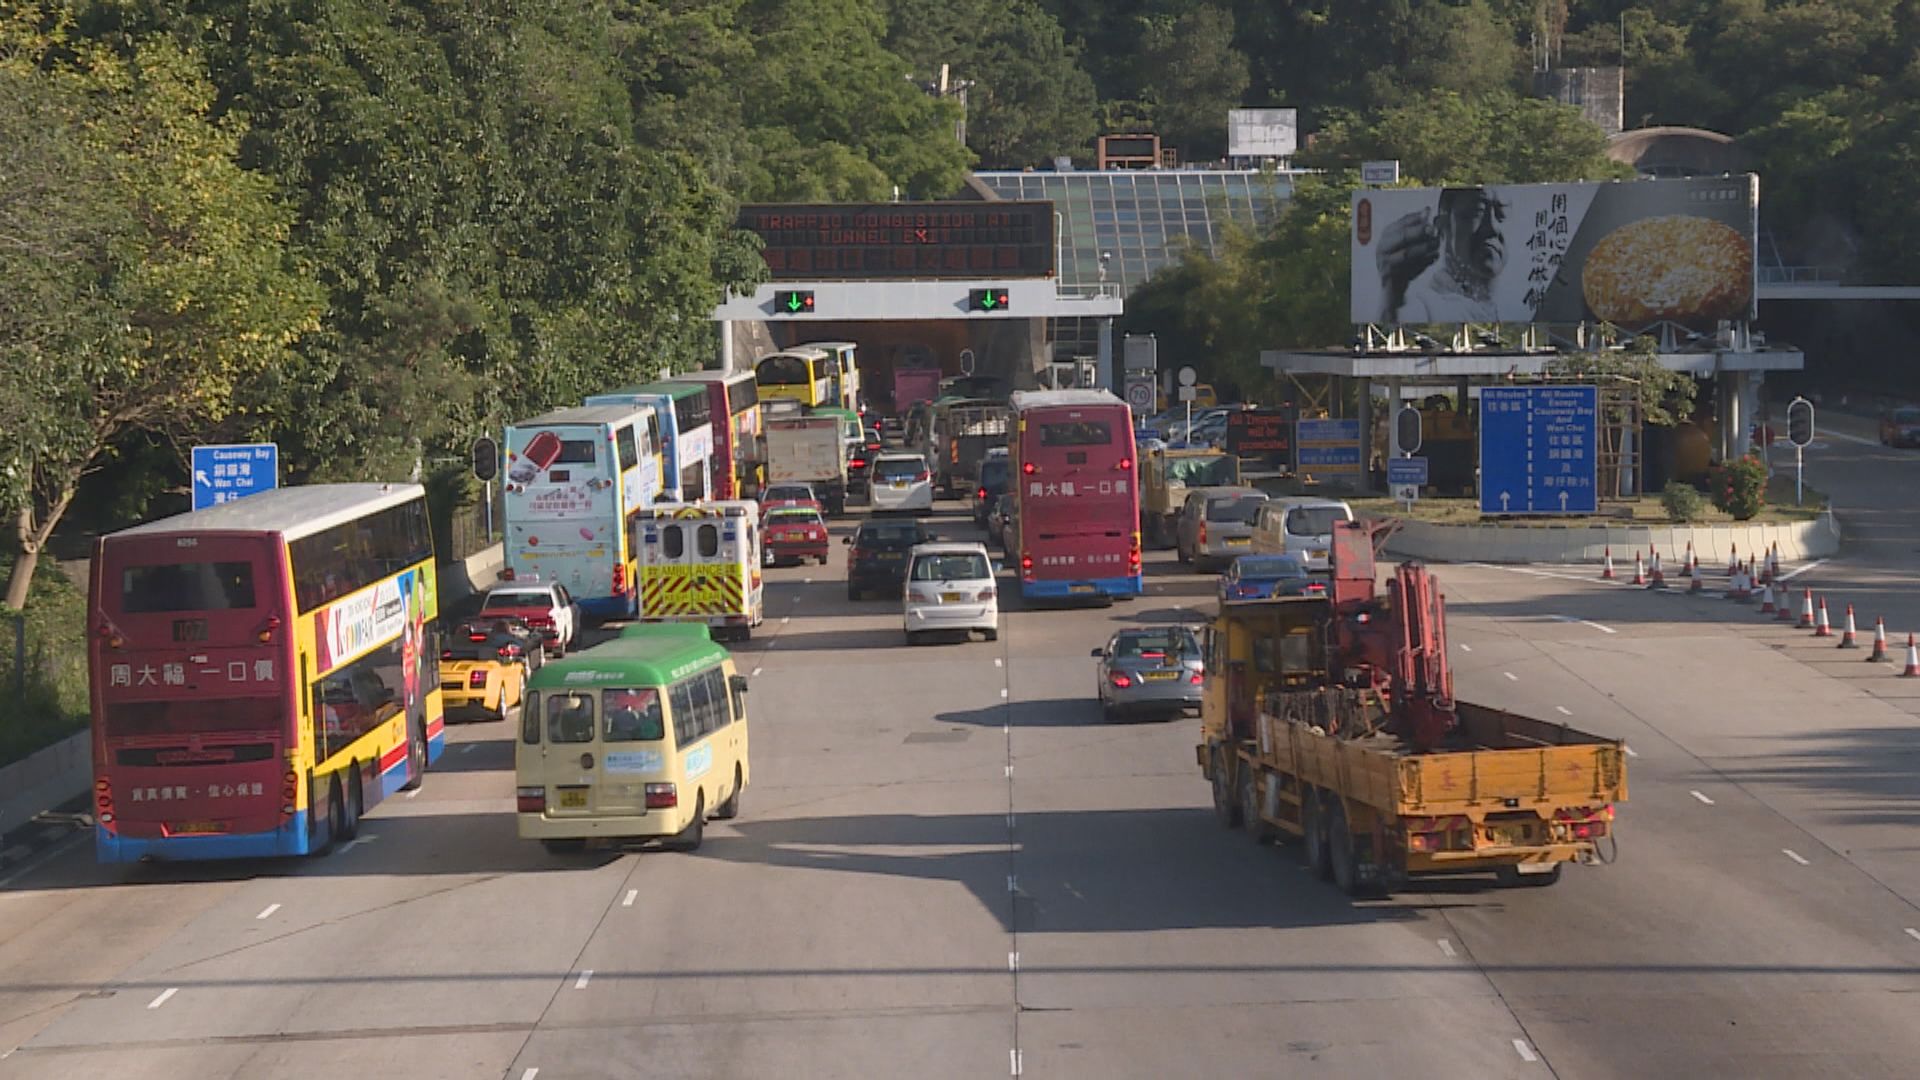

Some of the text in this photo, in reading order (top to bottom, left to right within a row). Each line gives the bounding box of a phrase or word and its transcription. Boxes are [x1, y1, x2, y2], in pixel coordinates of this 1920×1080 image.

[759, 213, 842, 229] TRAFFIC
[855, 213, 976, 228] CONGESTION
[820, 228, 951, 244] TUNNEL EXIT
[1134, 390, 1148, 400] 70
[1546, 424, 1585, 432] Wan Chai
[213, 447, 271, 461] Causeway Bay
[213, 477, 254, 488] Wan Chai
[662, 564, 723, 577] AMBULANCE
[110, 659, 275, 687] 周大福 一口價
